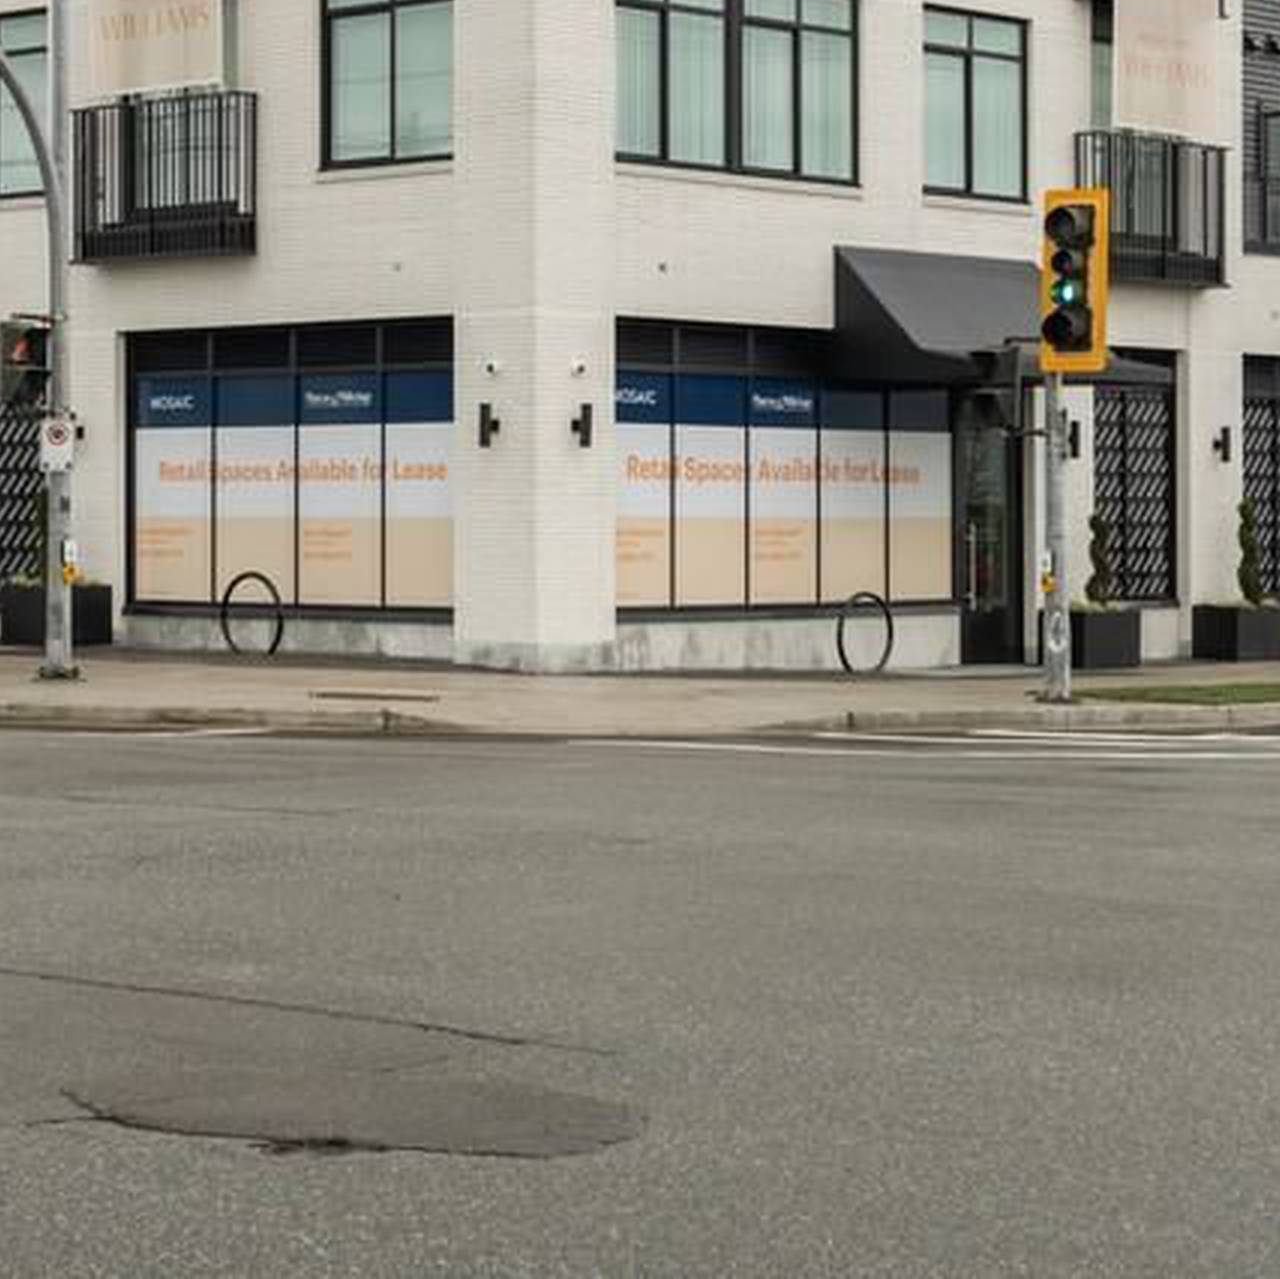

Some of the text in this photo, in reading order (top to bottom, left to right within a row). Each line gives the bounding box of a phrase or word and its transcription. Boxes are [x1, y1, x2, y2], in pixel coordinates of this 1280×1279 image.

[615, 389, 657, 406] OSAIC
[361, 456, 385, 482] fo
[758, 456, 839, 483] Availale
[871, 459, 920, 484] Lase
